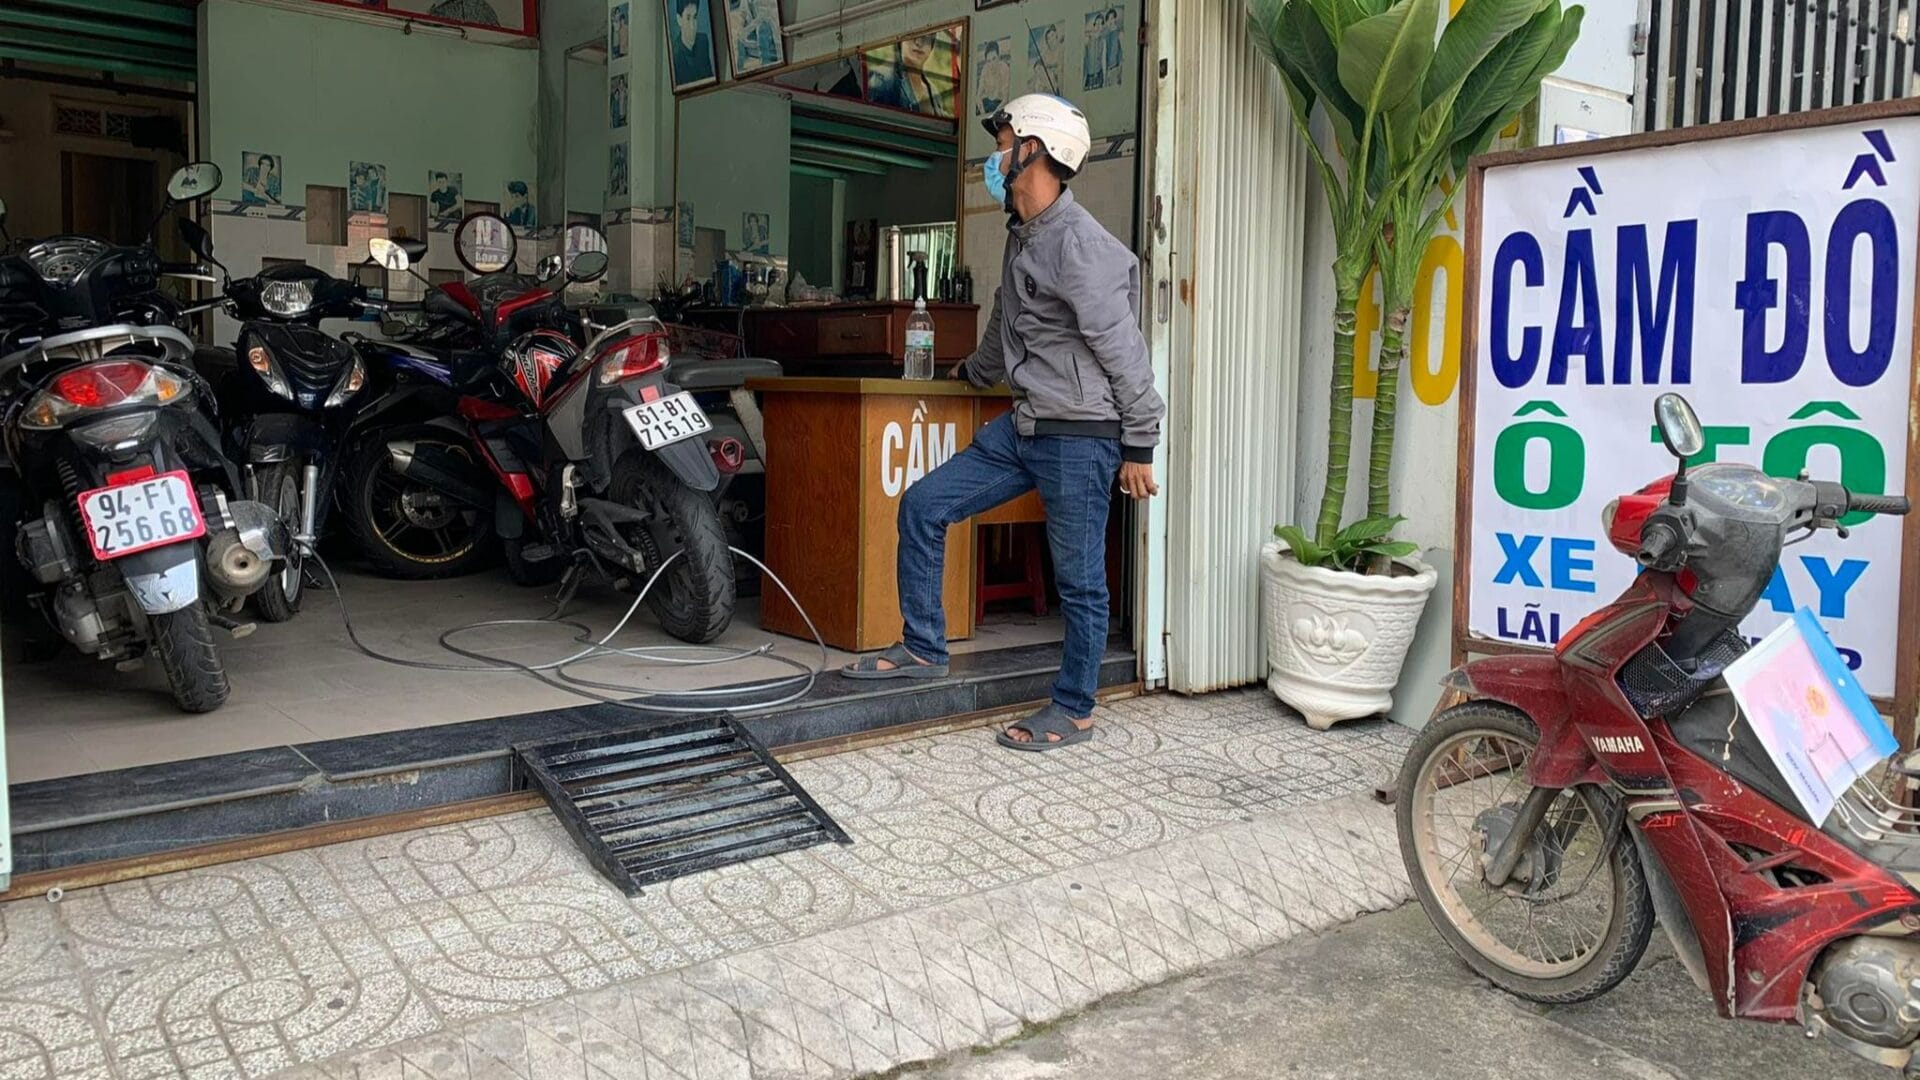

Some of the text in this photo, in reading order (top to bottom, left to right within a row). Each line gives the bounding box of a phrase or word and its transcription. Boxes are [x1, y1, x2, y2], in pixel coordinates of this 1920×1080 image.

[1490, 129, 1899, 388] CẦM ĐỒ
[636, 398, 687, 425] 61-B1
[640, 412, 706, 446] 715.19
[881, 400, 957, 498] CẦM
[1494, 400, 1585, 510] Ô
[98, 479, 175, 520] 94-F1
[97, 506, 195, 551] 256.68
[1493, 532, 1596, 593] XE
[1497, 603, 1560, 644] LÃI
[1591, 735, 1645, 753] YAMAHA
